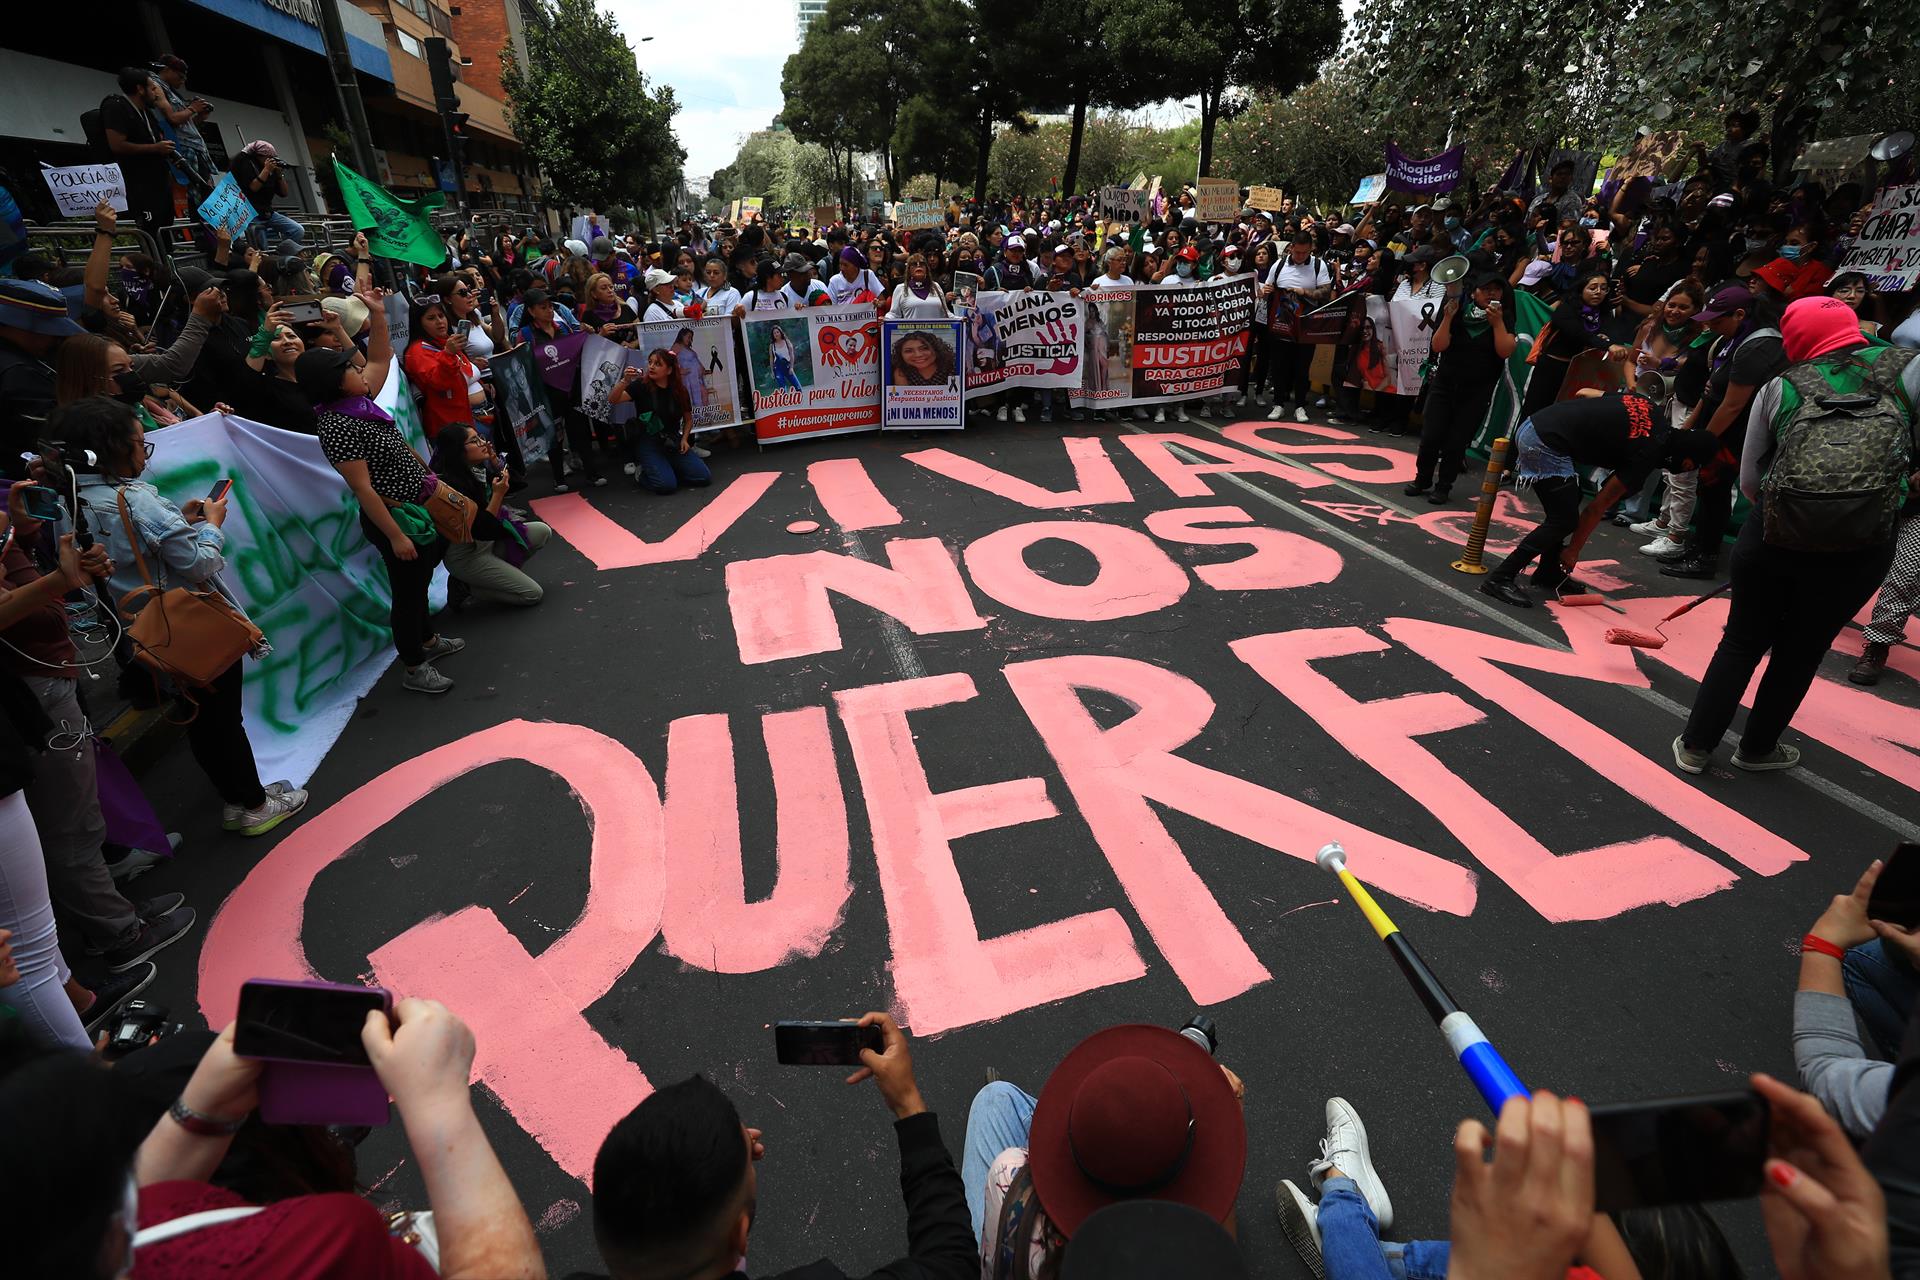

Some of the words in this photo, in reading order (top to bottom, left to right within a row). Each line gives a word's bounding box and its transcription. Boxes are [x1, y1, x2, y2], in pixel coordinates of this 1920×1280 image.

[50, 168, 105, 187] POLICÍA
[1103, 205, 1140, 222] MIEDO
[1861, 213, 1915, 240] CHAPA
[1155, 294, 1170, 304] YA
[1173, 293, 1202, 303] NADA
[1215, 284, 1251, 299] CALLA,
[995, 305, 1013, 322] NI
[1015, 292, 1054, 313] UNA
[1155, 306, 1170, 317] YA
[1173, 305, 1204, 316] TODO
[1217, 296, 1253, 312] SOBRA
[644, 322, 680, 332] Estamos
[999, 302, 1077, 340] MENOS
[1172, 319, 1182, 329] SI
[1220, 314, 1228, 324] A
[1137, 328, 1220, 342] RESPONDEMOS
[1002, 343, 1078, 361] JUSTICIA
[1142, 336, 1245, 366] JUSTICIA
[968, 372, 1001, 387] NIKITA
[1003, 364, 1031, 378] SOTO
[1145, 365, 1182, 381] PARA
[1185, 357, 1240, 378] CRISTINA
[809, 387, 836, 406] para
[841, 378, 880, 399] Valer
[1160, 384, 1170, 394] Y
[1173, 382, 1191, 394] SU
[888, 408, 900, 421] ¡NI
[903, 407, 921, 420] UNA
[923, 407, 958, 420] MENOS!
[530, 422, 1417, 570] VIVAS
[726, 506, 1343, 664] NOS
